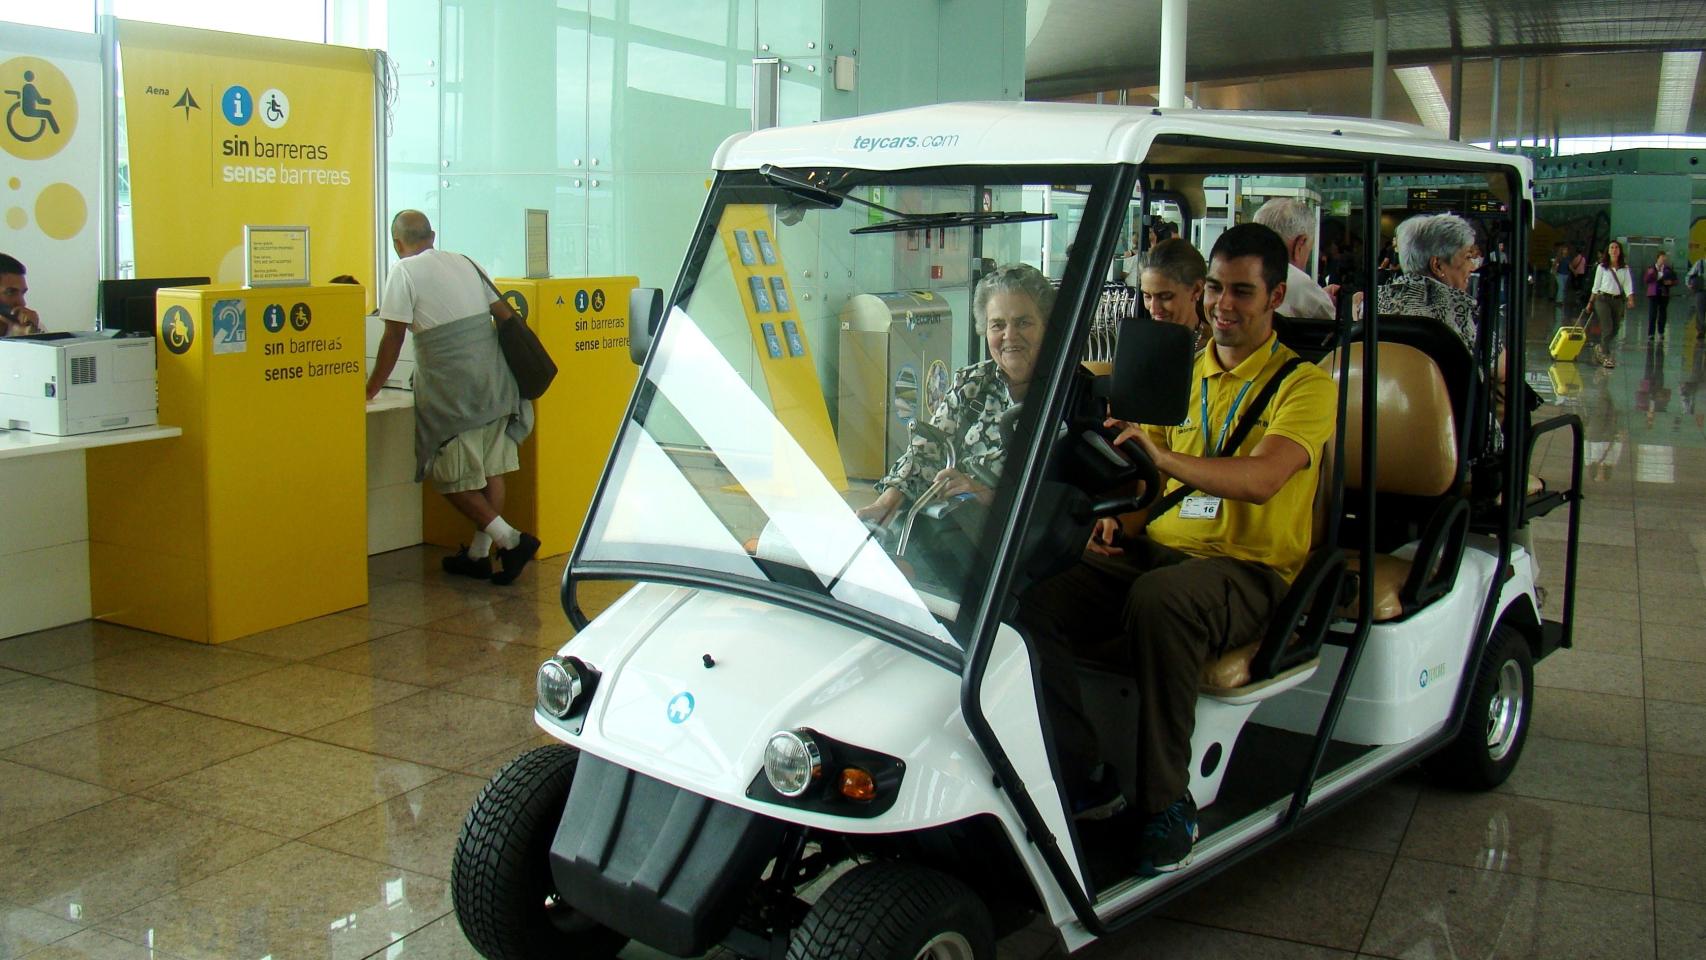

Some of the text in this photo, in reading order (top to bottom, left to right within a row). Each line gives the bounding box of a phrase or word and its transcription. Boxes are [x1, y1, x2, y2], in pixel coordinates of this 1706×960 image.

[145, 85, 170, 96] Aena
[222, 135, 328, 160] sin barreras
[853, 134, 960, 152] teycars.com
[223, 163, 351, 186] sense barreres
[575, 317, 624, 331] sin barreras
[264, 339, 284, 355] sin
[575, 336, 630, 351] sense barrere
[264, 360, 360, 381] sense barreres
